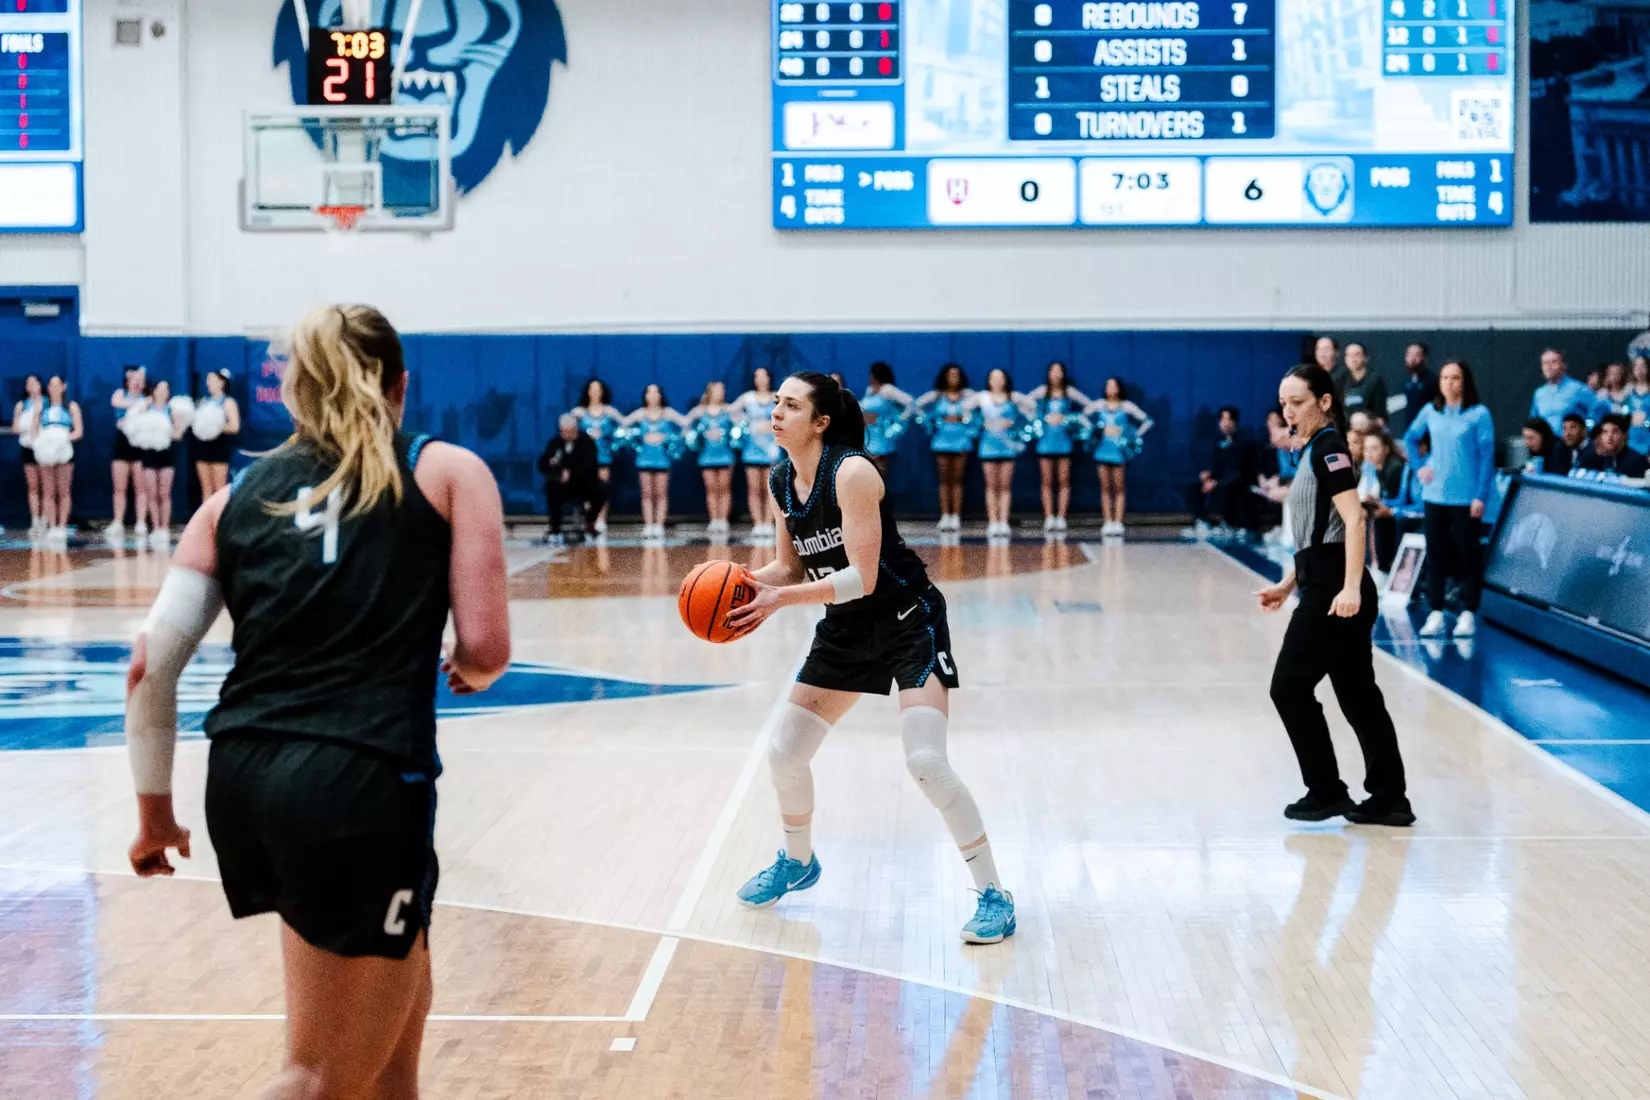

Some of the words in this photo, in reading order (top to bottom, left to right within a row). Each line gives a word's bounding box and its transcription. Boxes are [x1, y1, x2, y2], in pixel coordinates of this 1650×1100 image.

[1082, 2, 1199, 29] REBOUNDS
[1231, 3, 1247, 25] 7
[330, 31, 385, 59] 7:03
[1093, 39, 1187, 66] ASSISTS
[1231, 38, 1247, 61] 1
[323, 58, 374, 102] 21
[1035, 76, 1050, 98] 1
[1100, 74, 1180, 102] STEALS
[1075, 110, 1204, 138] TURNOVERS
[1231, 111, 1247, 134] 1
[1020, 180, 1039, 202] 0
[1112, 173, 1170, 190] 7:03
[1244, 179, 1263, 201] 6
[792, 526, 844, 556] olumbia
[937, 651, 954, 675] C
[384, 888, 414, 935] C
